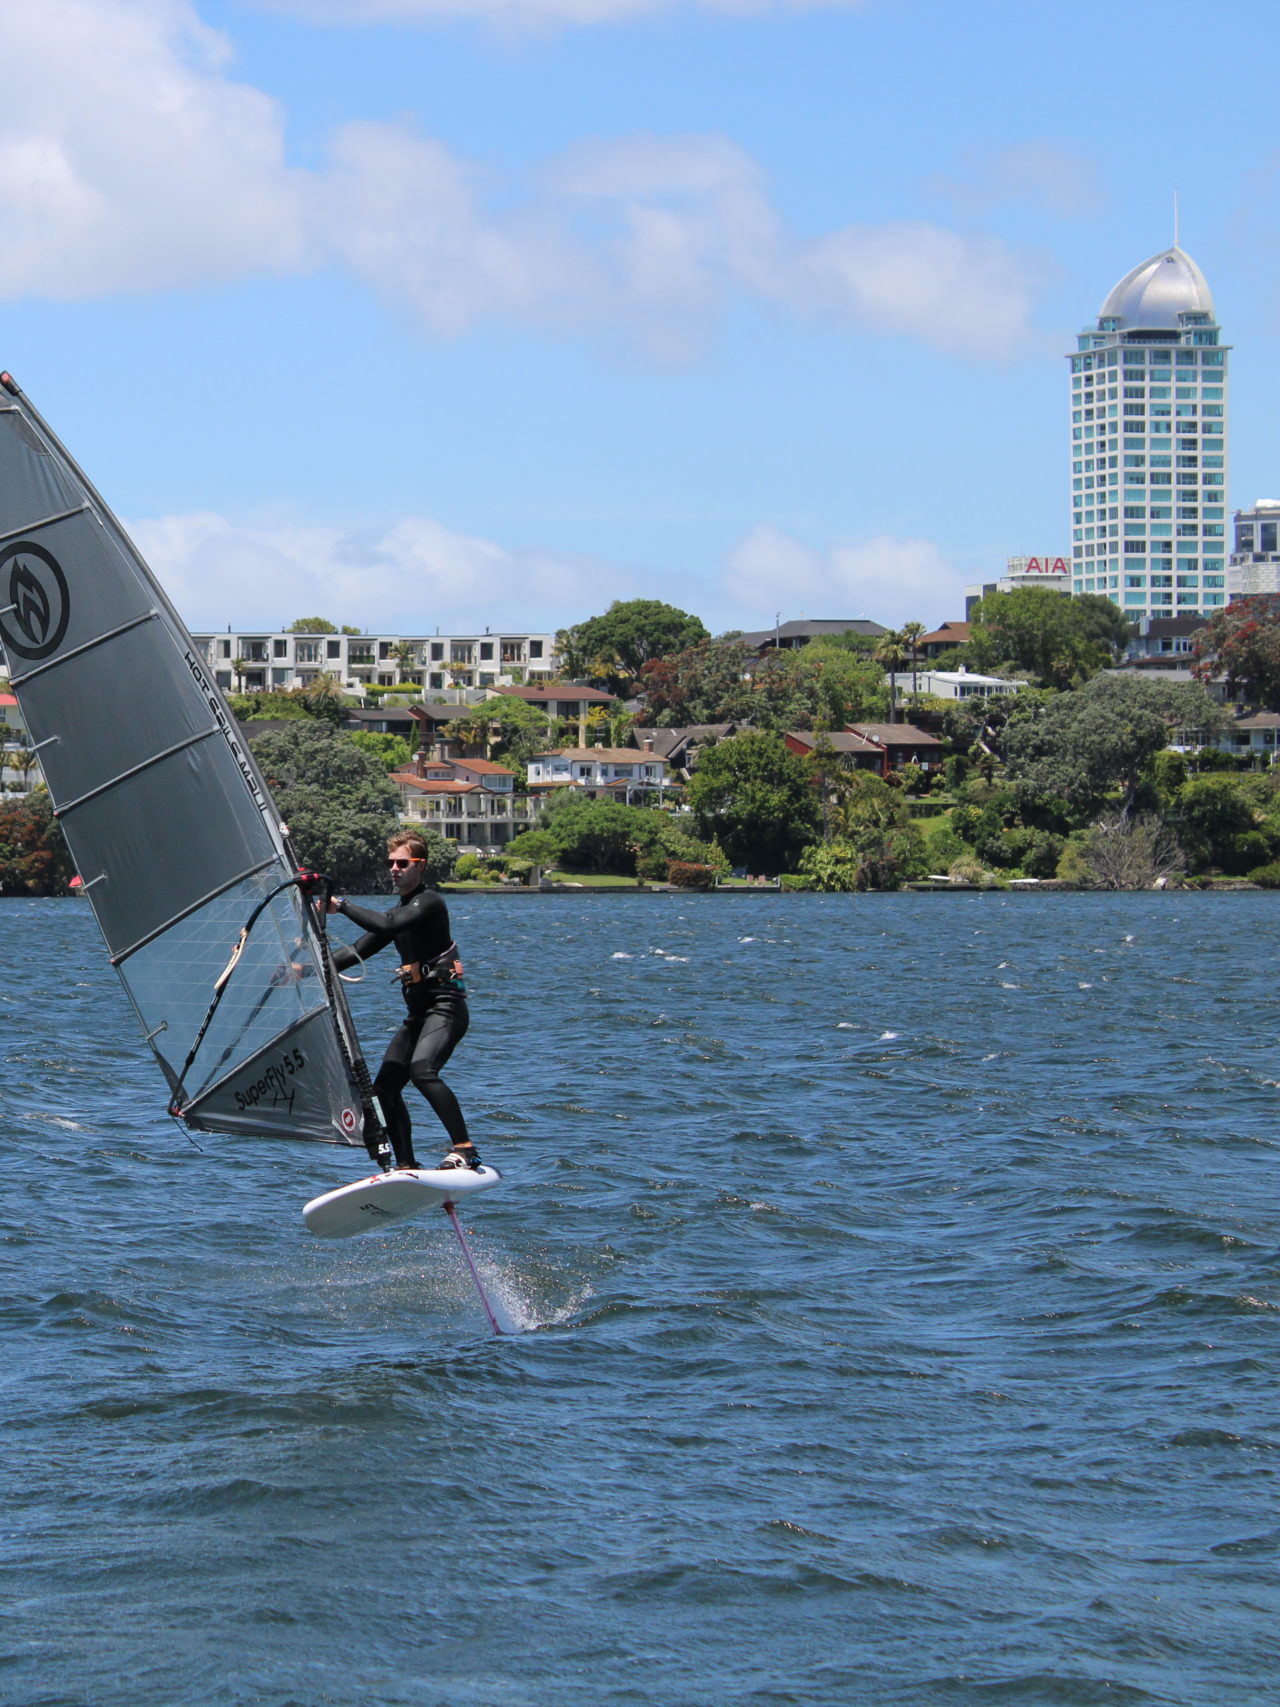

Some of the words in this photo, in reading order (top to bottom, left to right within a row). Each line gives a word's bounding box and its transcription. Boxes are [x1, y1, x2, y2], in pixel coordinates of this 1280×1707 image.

[1025, 557, 1068, 574] AIA
[184, 651, 210, 692] HOT
[234, 1063, 287, 1111] SuperFly
[283, 1047, 305, 1075] 5.5
